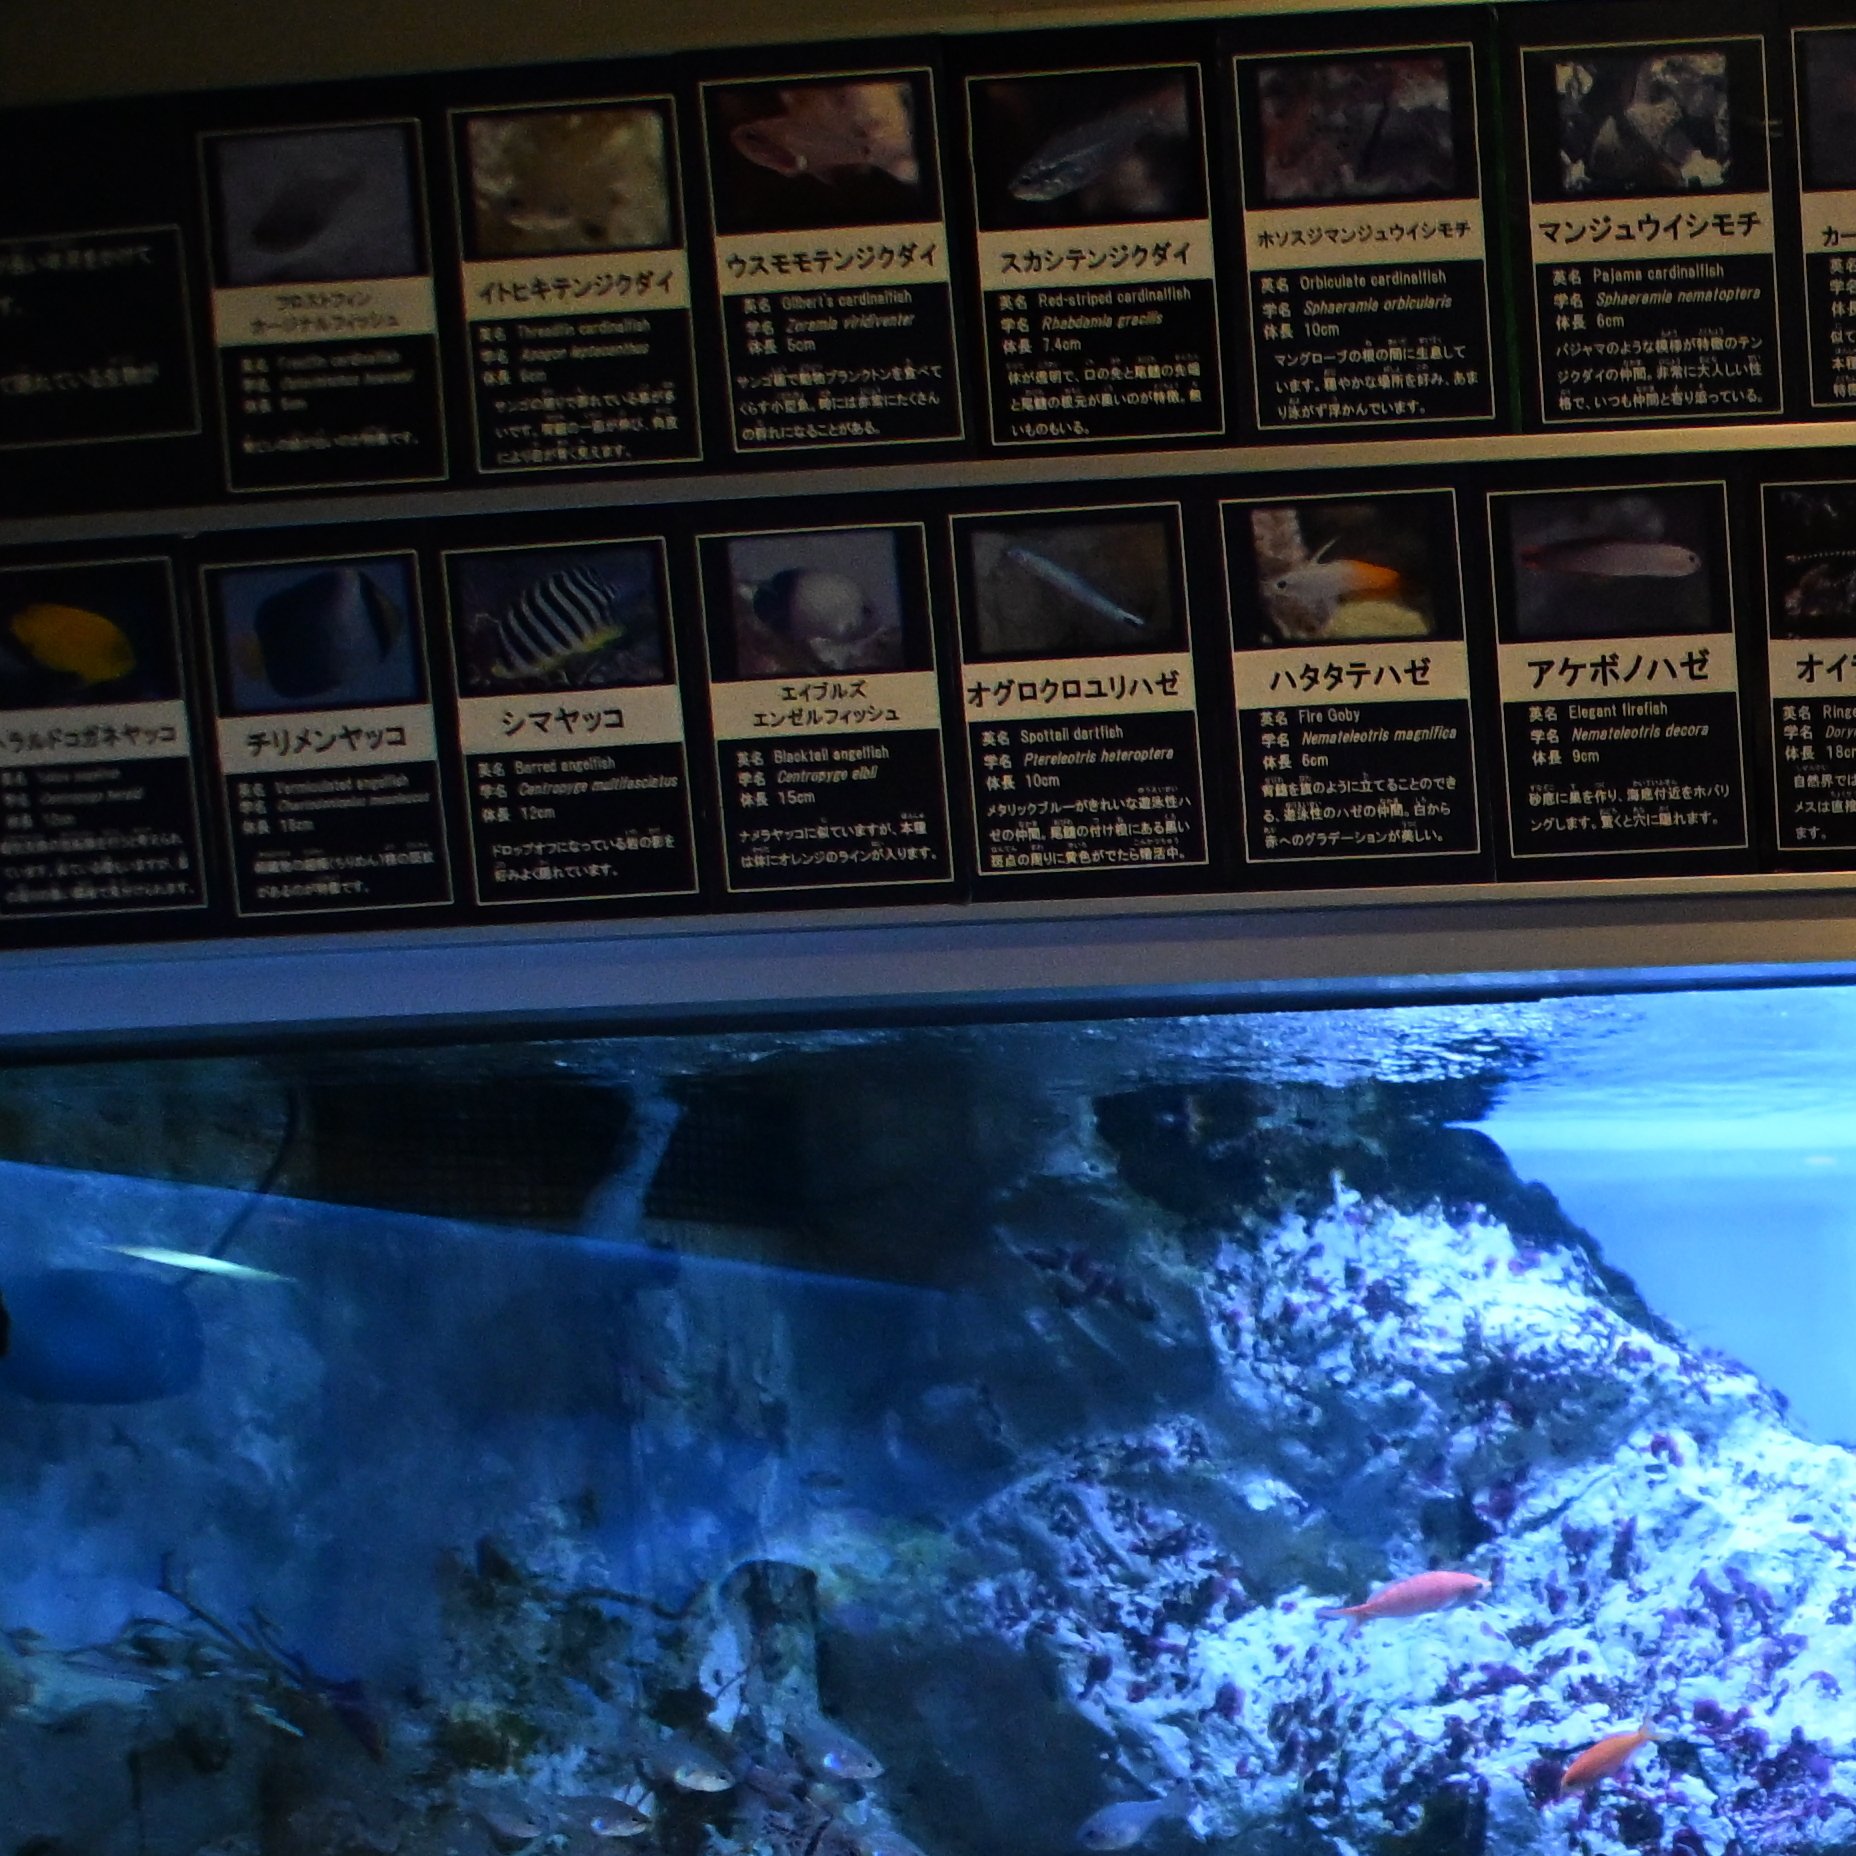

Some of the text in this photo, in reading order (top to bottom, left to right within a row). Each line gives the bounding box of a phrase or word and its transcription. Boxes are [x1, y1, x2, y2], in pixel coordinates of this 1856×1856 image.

[1257, 220, 1471, 248] ホソスジマンジュウイシモチ
[1538, 207, 1761, 246] マンジュウイシモチ
[726, 241, 937, 277] ウスモモテンジクダイ
[1000, 240, 1191, 274] スカシテンジクダイ
[479, 269, 674, 303] イトヒキテンジクダイ
[1260, 269, 1446, 294] 英名 Orbiculate cardinalfish
[1552, 262, 1724, 286] 英名 Pajama cardinalfish
[998, 285, 1191, 311] 英名 Red-striped cardinalfish
[1261, 301, 1291, 319] 学名
[1269, 657, 1432, 693] ハタタテハゼ
[1527, 648, 1711, 689] アケボノハゼ
[781, 680, 867, 702] エイブルズ
[966, 669, 1180, 707] オグロクロユリハゼ
[501, 705, 624, 737] シマヤッコ
[752, 703, 899, 728] エンゼルフィッシュ
[1259, 707, 1360, 727] 英名 Fire Goby
[1528, 701, 1668, 722] 英名 Elegant firefish
[1782, 705, 1811, 721] 英名
[247, 721, 407, 757] チリメンヤッコ
[981, 724, 1123, 747] 英名 Spottail dartfish
[1261, 725, 1457, 748] 学名 Nemateleotris magnifica
[1783, 724, 1812, 740] 学名
[735, 744, 889, 767] 英名 Blacktail angelfish
[1262, 754, 1292, 770] 体長
[476, 761, 505, 778] 英名
[514, 759, 557, 775] Barred
[1795, 826, 1826, 840] ます。
